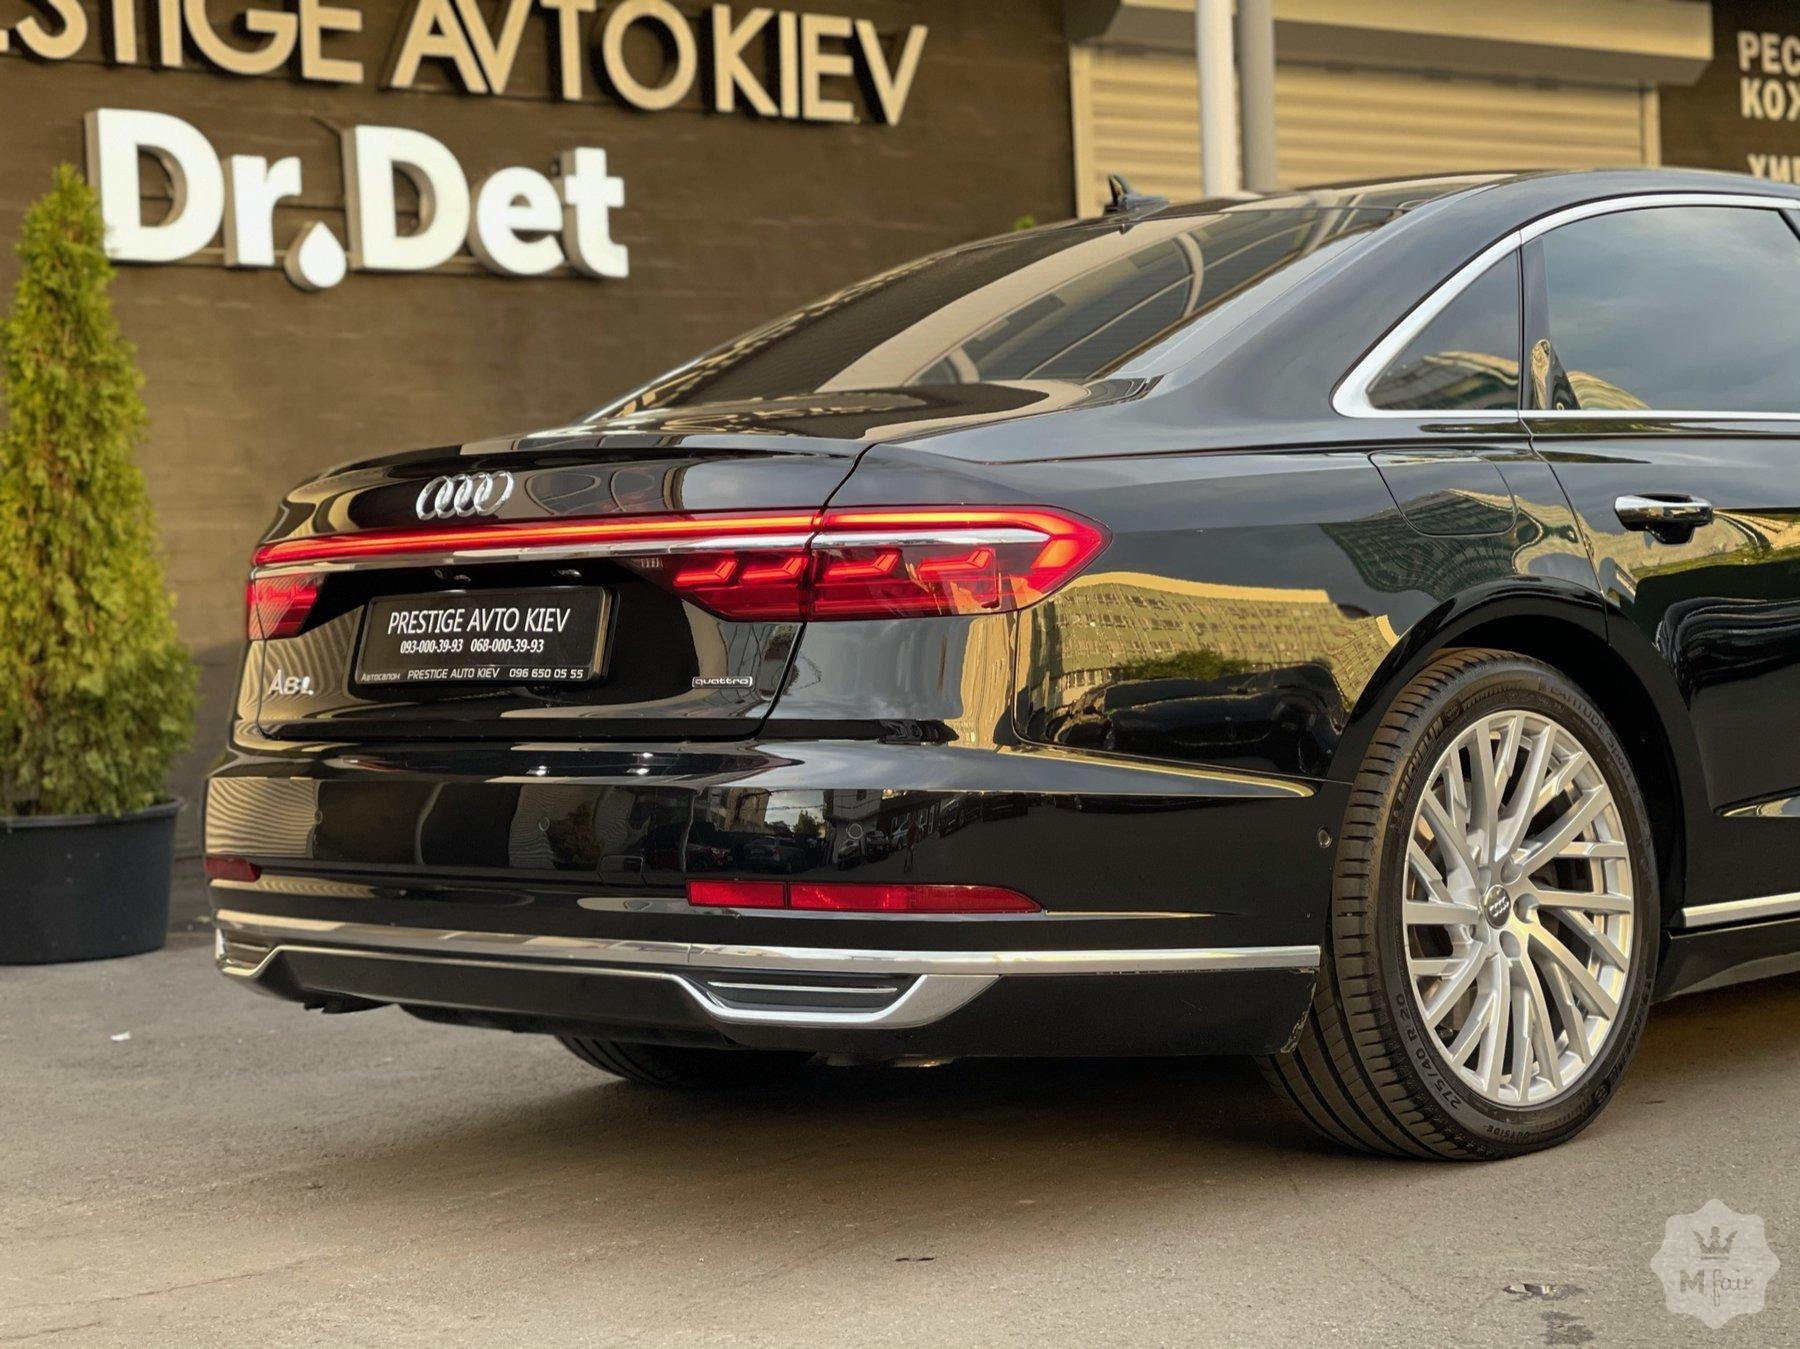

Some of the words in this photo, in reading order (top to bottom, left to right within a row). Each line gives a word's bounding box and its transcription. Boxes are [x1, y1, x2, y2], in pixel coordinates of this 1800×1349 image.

[0, 0, 363, 83] SIGE
[391, 0, 697, 110] AVTO
[712, 3, 929, 126] KIEV
[1747, 153, 1800, 184] ХИ
[92, 108, 629, 289] Dr.Det
[387, 608, 466, 635] PRESTIGE
[466, 607, 520, 632] AVTO
[524, 607, 571, 632] KIEV
[400, 638, 464, 654] 093-000-39-93
[470, 638, 545, 654] 068-000-39-93
[407, 669, 449, 680] PRESTIGE
[450, 668, 475, 678] AUTO
[476, 668, 500, 678] KIEV
[509, 668, 529, 678] 096
[531, 668, 551, 678] 650
[553, 668, 567, 679] 05
[569, 669, 584, 679] 55
[694, 677, 750, 687] quattro
[1397, 716, 1443, 804] MICHELIN
[1396, 993, 1411, 1021] 20
[1415, 1048, 1463, 1110] 275/40
